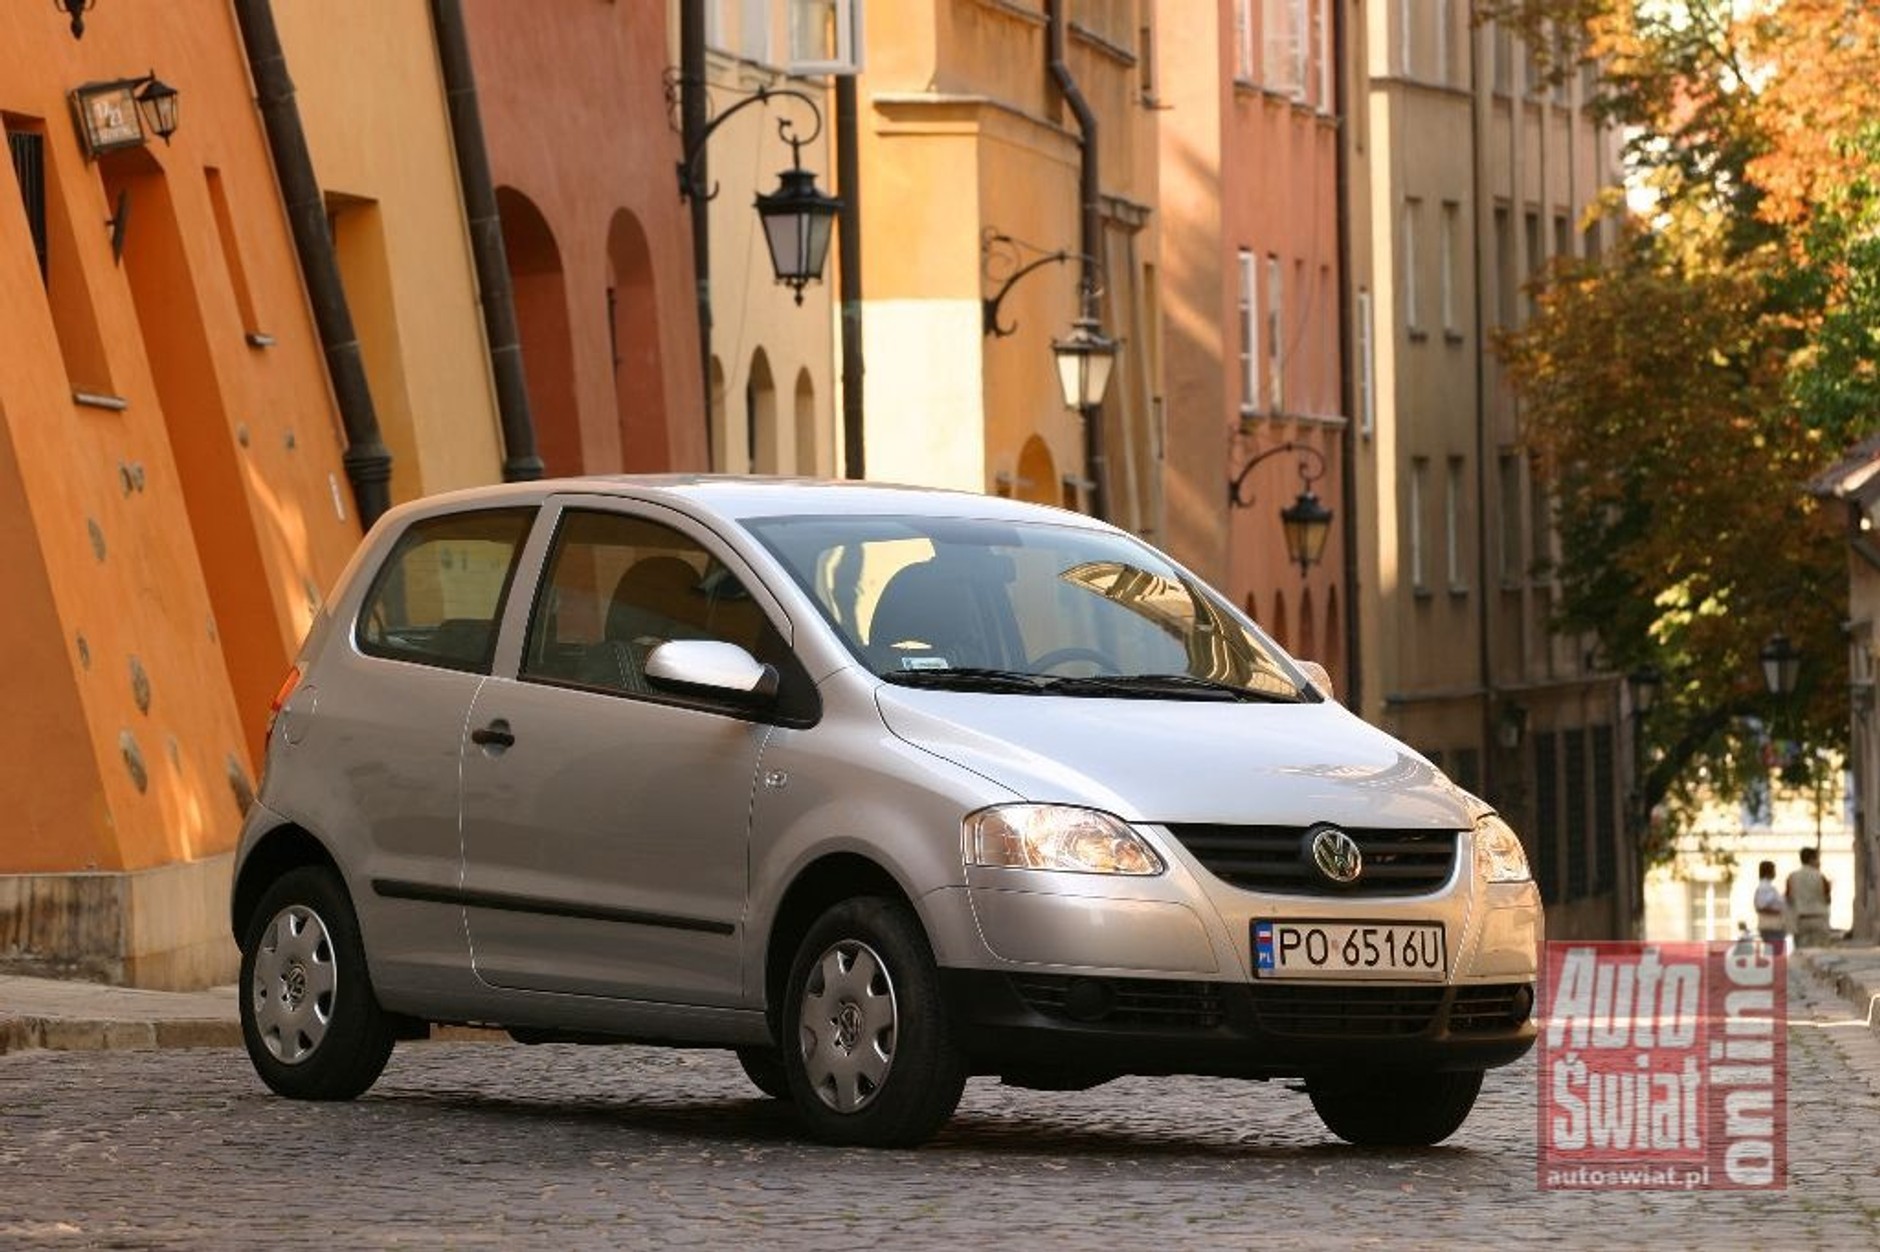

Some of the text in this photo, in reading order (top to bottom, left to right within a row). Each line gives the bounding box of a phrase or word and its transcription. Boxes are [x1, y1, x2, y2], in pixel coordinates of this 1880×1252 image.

[1258, 952, 1272, 963] PL
[1279, 929, 1439, 967] PO 6516U
